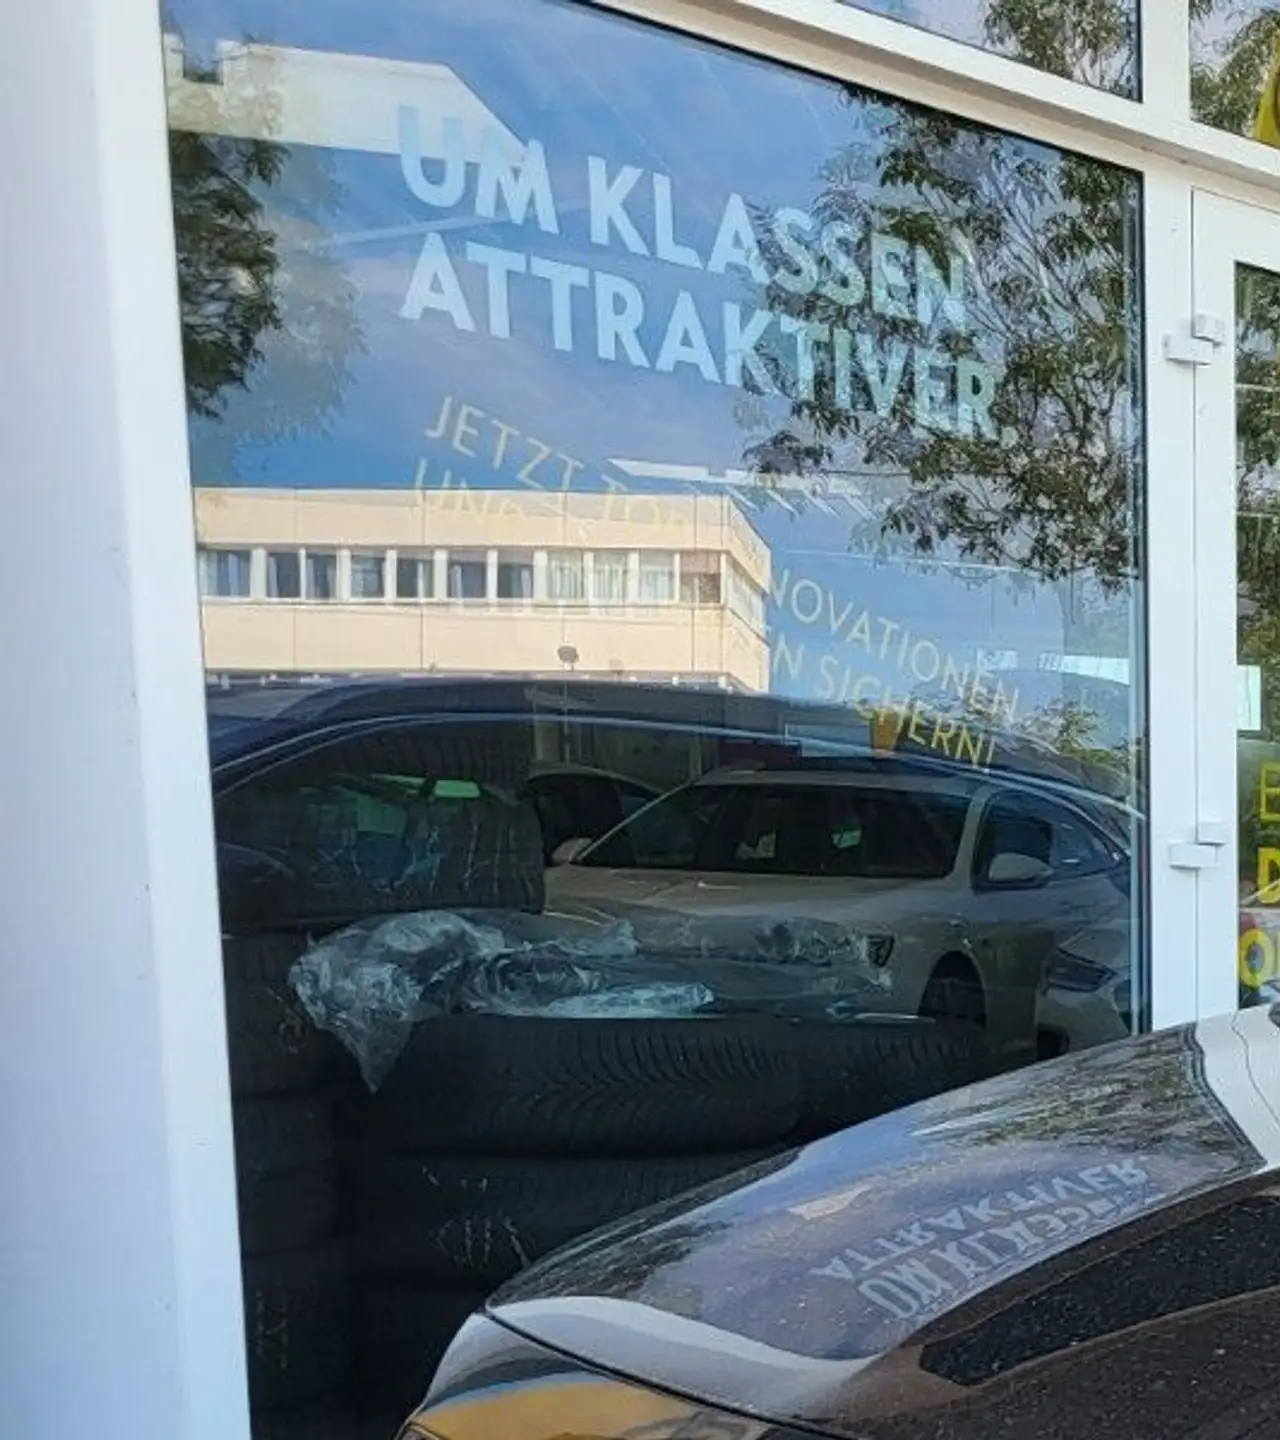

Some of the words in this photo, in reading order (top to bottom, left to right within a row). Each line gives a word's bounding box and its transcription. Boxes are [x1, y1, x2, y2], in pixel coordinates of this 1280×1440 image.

[402, 103, 560, 237] UM
[588, 154, 966, 334] KLASSEN
[424, 395, 585, 495] JETZT
[769, 567, 1020, 726] NOVATIONEN
